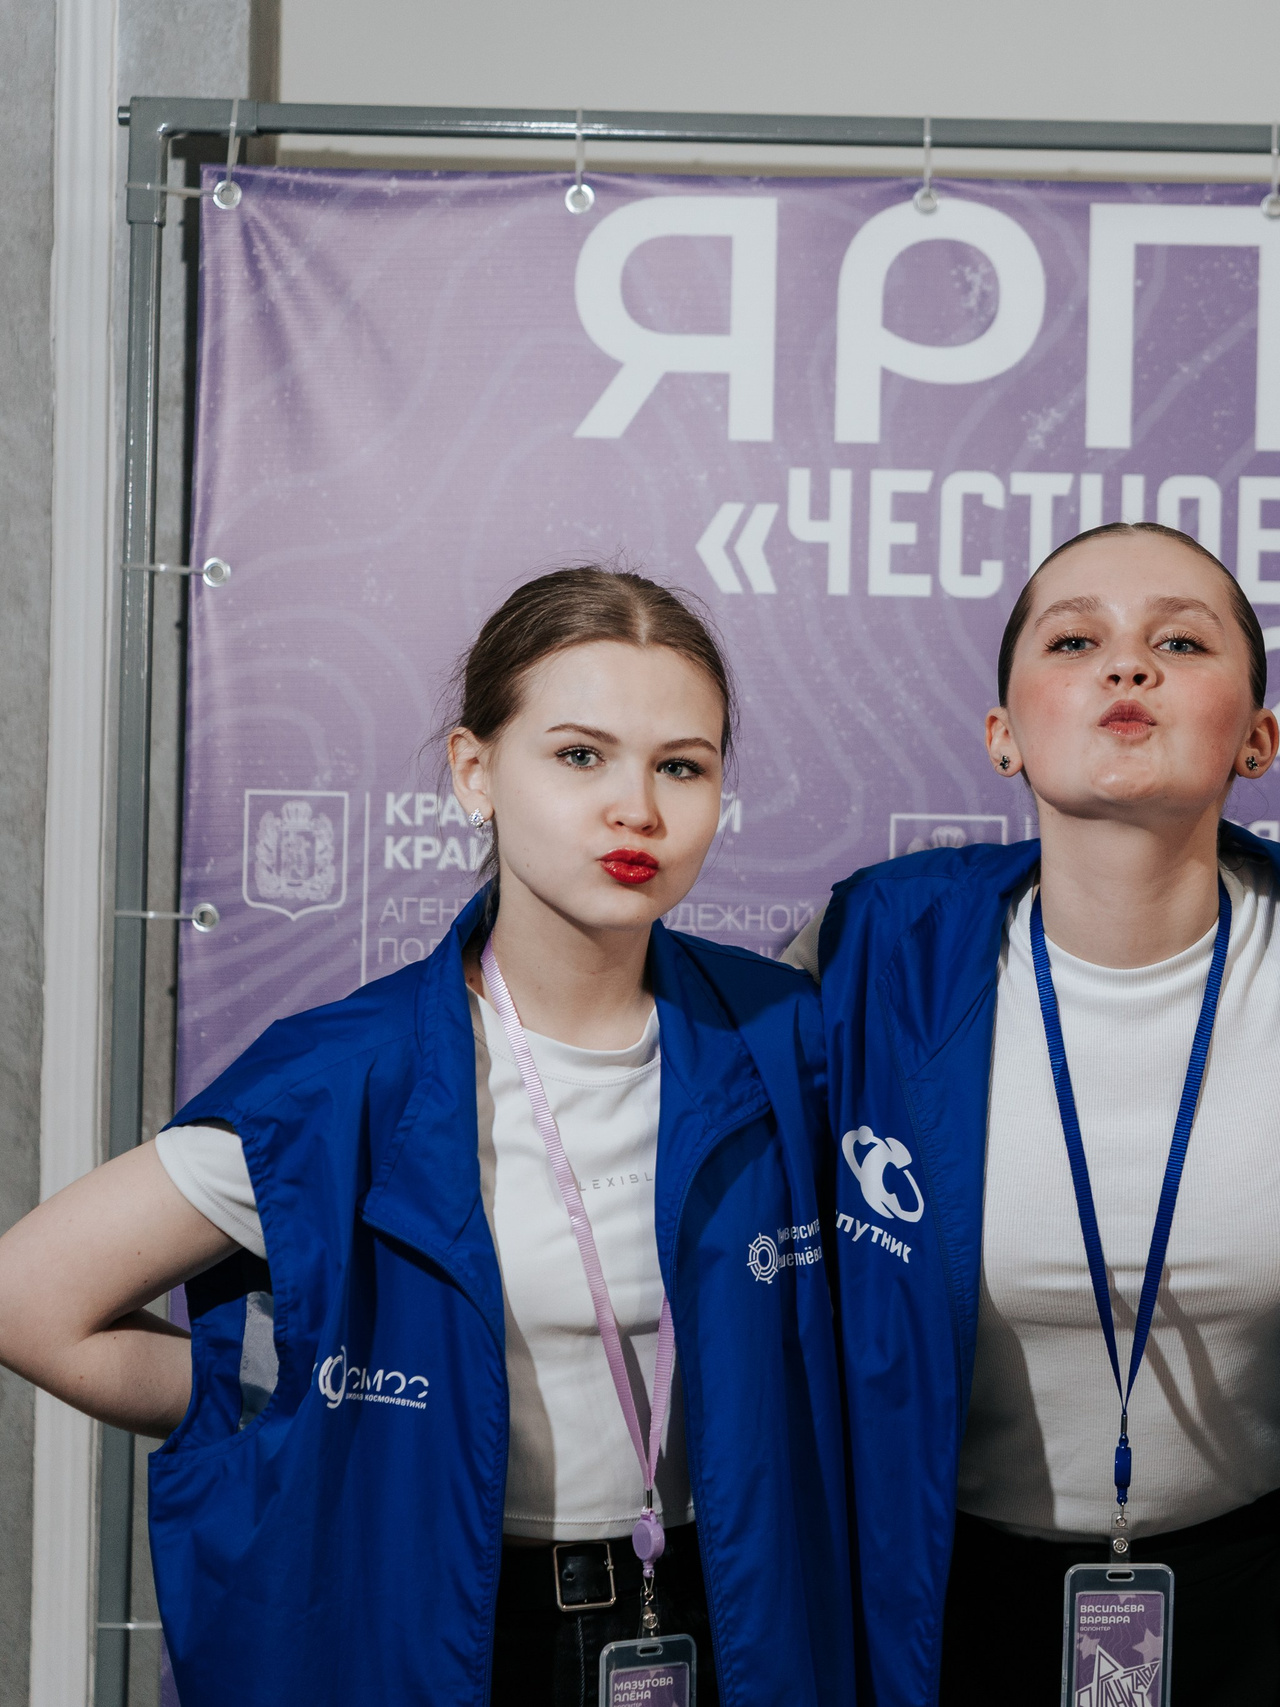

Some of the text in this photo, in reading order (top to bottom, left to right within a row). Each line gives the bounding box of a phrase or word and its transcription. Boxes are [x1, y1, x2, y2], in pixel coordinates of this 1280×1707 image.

[663, 902, 814, 933] ДЕЖНОЙ
[578, 1172, 653, 1192] LEXIBL
[1080, 1604, 1145, 1613] ВАСИЛЬЕВА
[1080, 1615, 1131, 1624] ВАРВАРА
[614, 1676, 674, 1691] МАЗУТОВА
